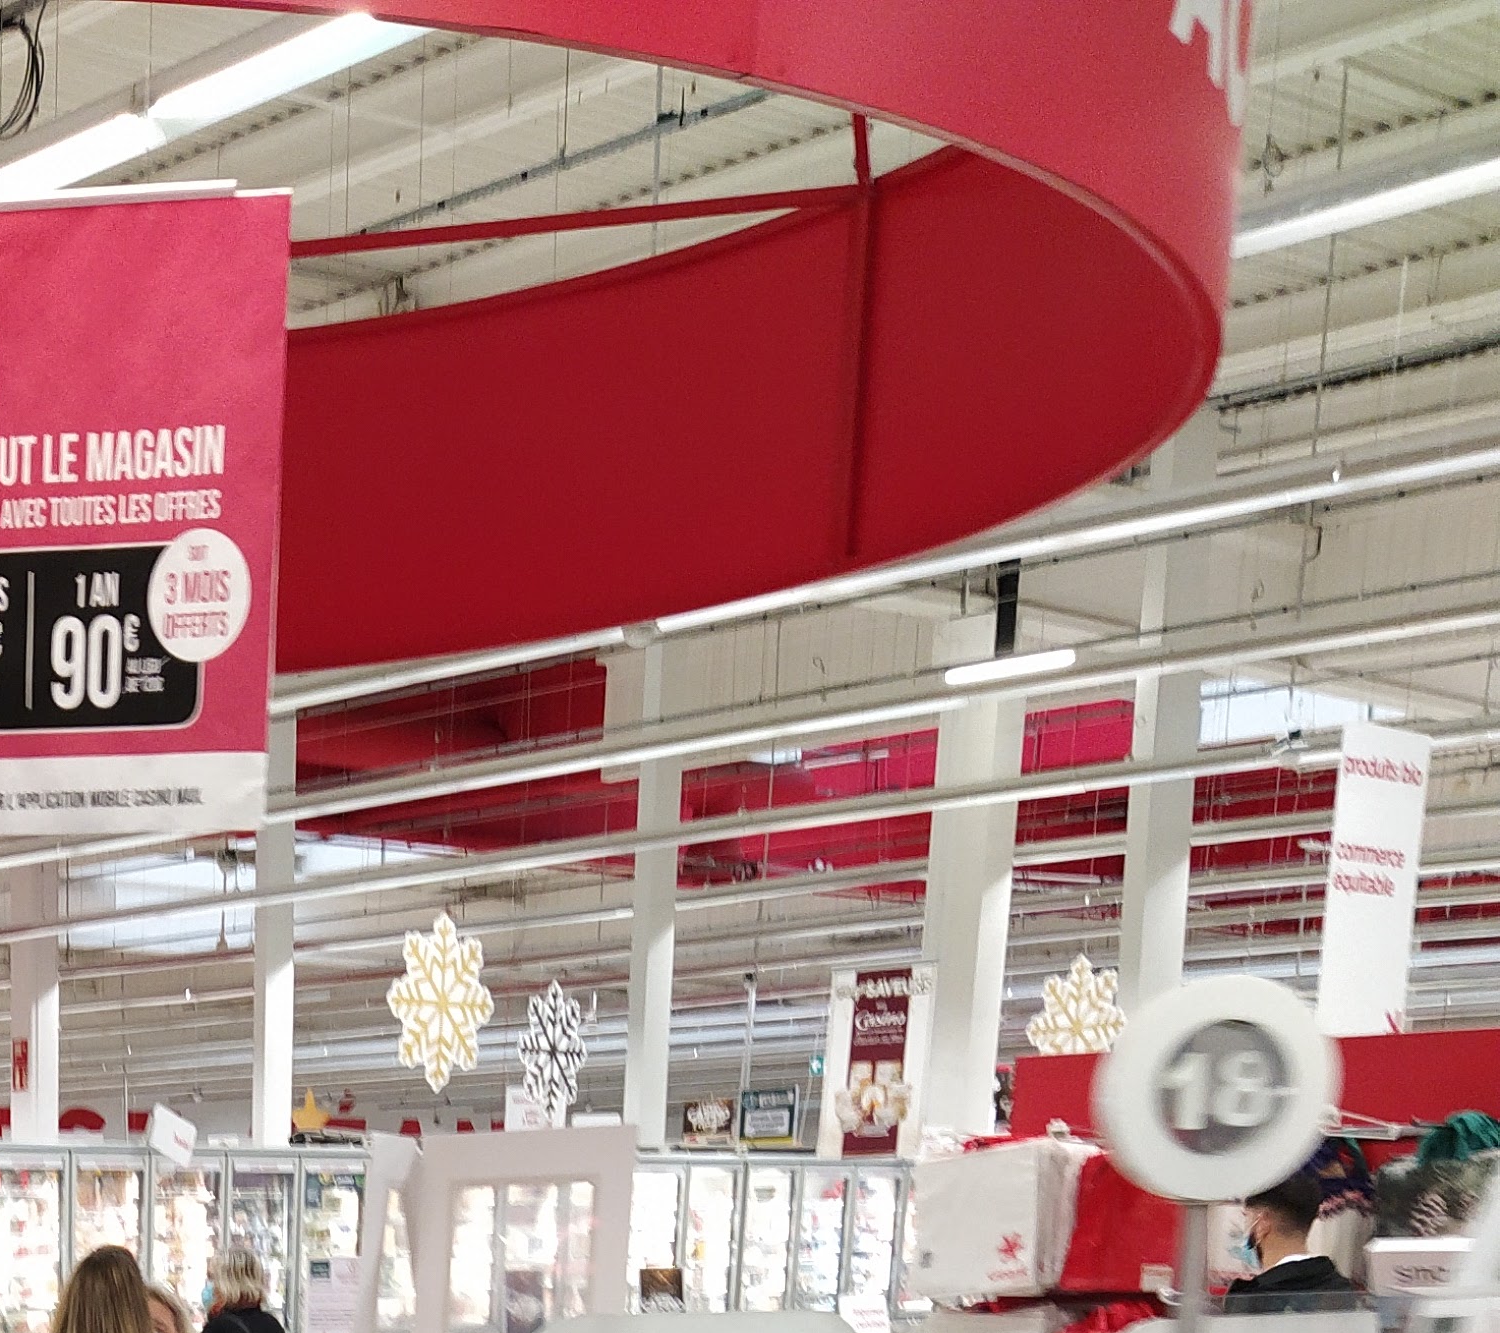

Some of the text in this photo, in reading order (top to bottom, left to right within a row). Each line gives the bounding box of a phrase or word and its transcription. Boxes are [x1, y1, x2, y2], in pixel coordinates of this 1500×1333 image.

[42, 433, 79, 483] LE
[86, 425, 226, 482] MAGASIN
[0, 498, 47, 530] AVEC
[48, 495, 117, 527] TOUTES
[118, 493, 152, 524] LES
[153, 489, 222, 522] OFFRES
[74, 571, 121, 608] 1 AN
[164, 569, 231, 605] 3 MOIS
[162, 611, 229, 639] OFFERTS
[1155, 1047, 1272, 1132] 18
